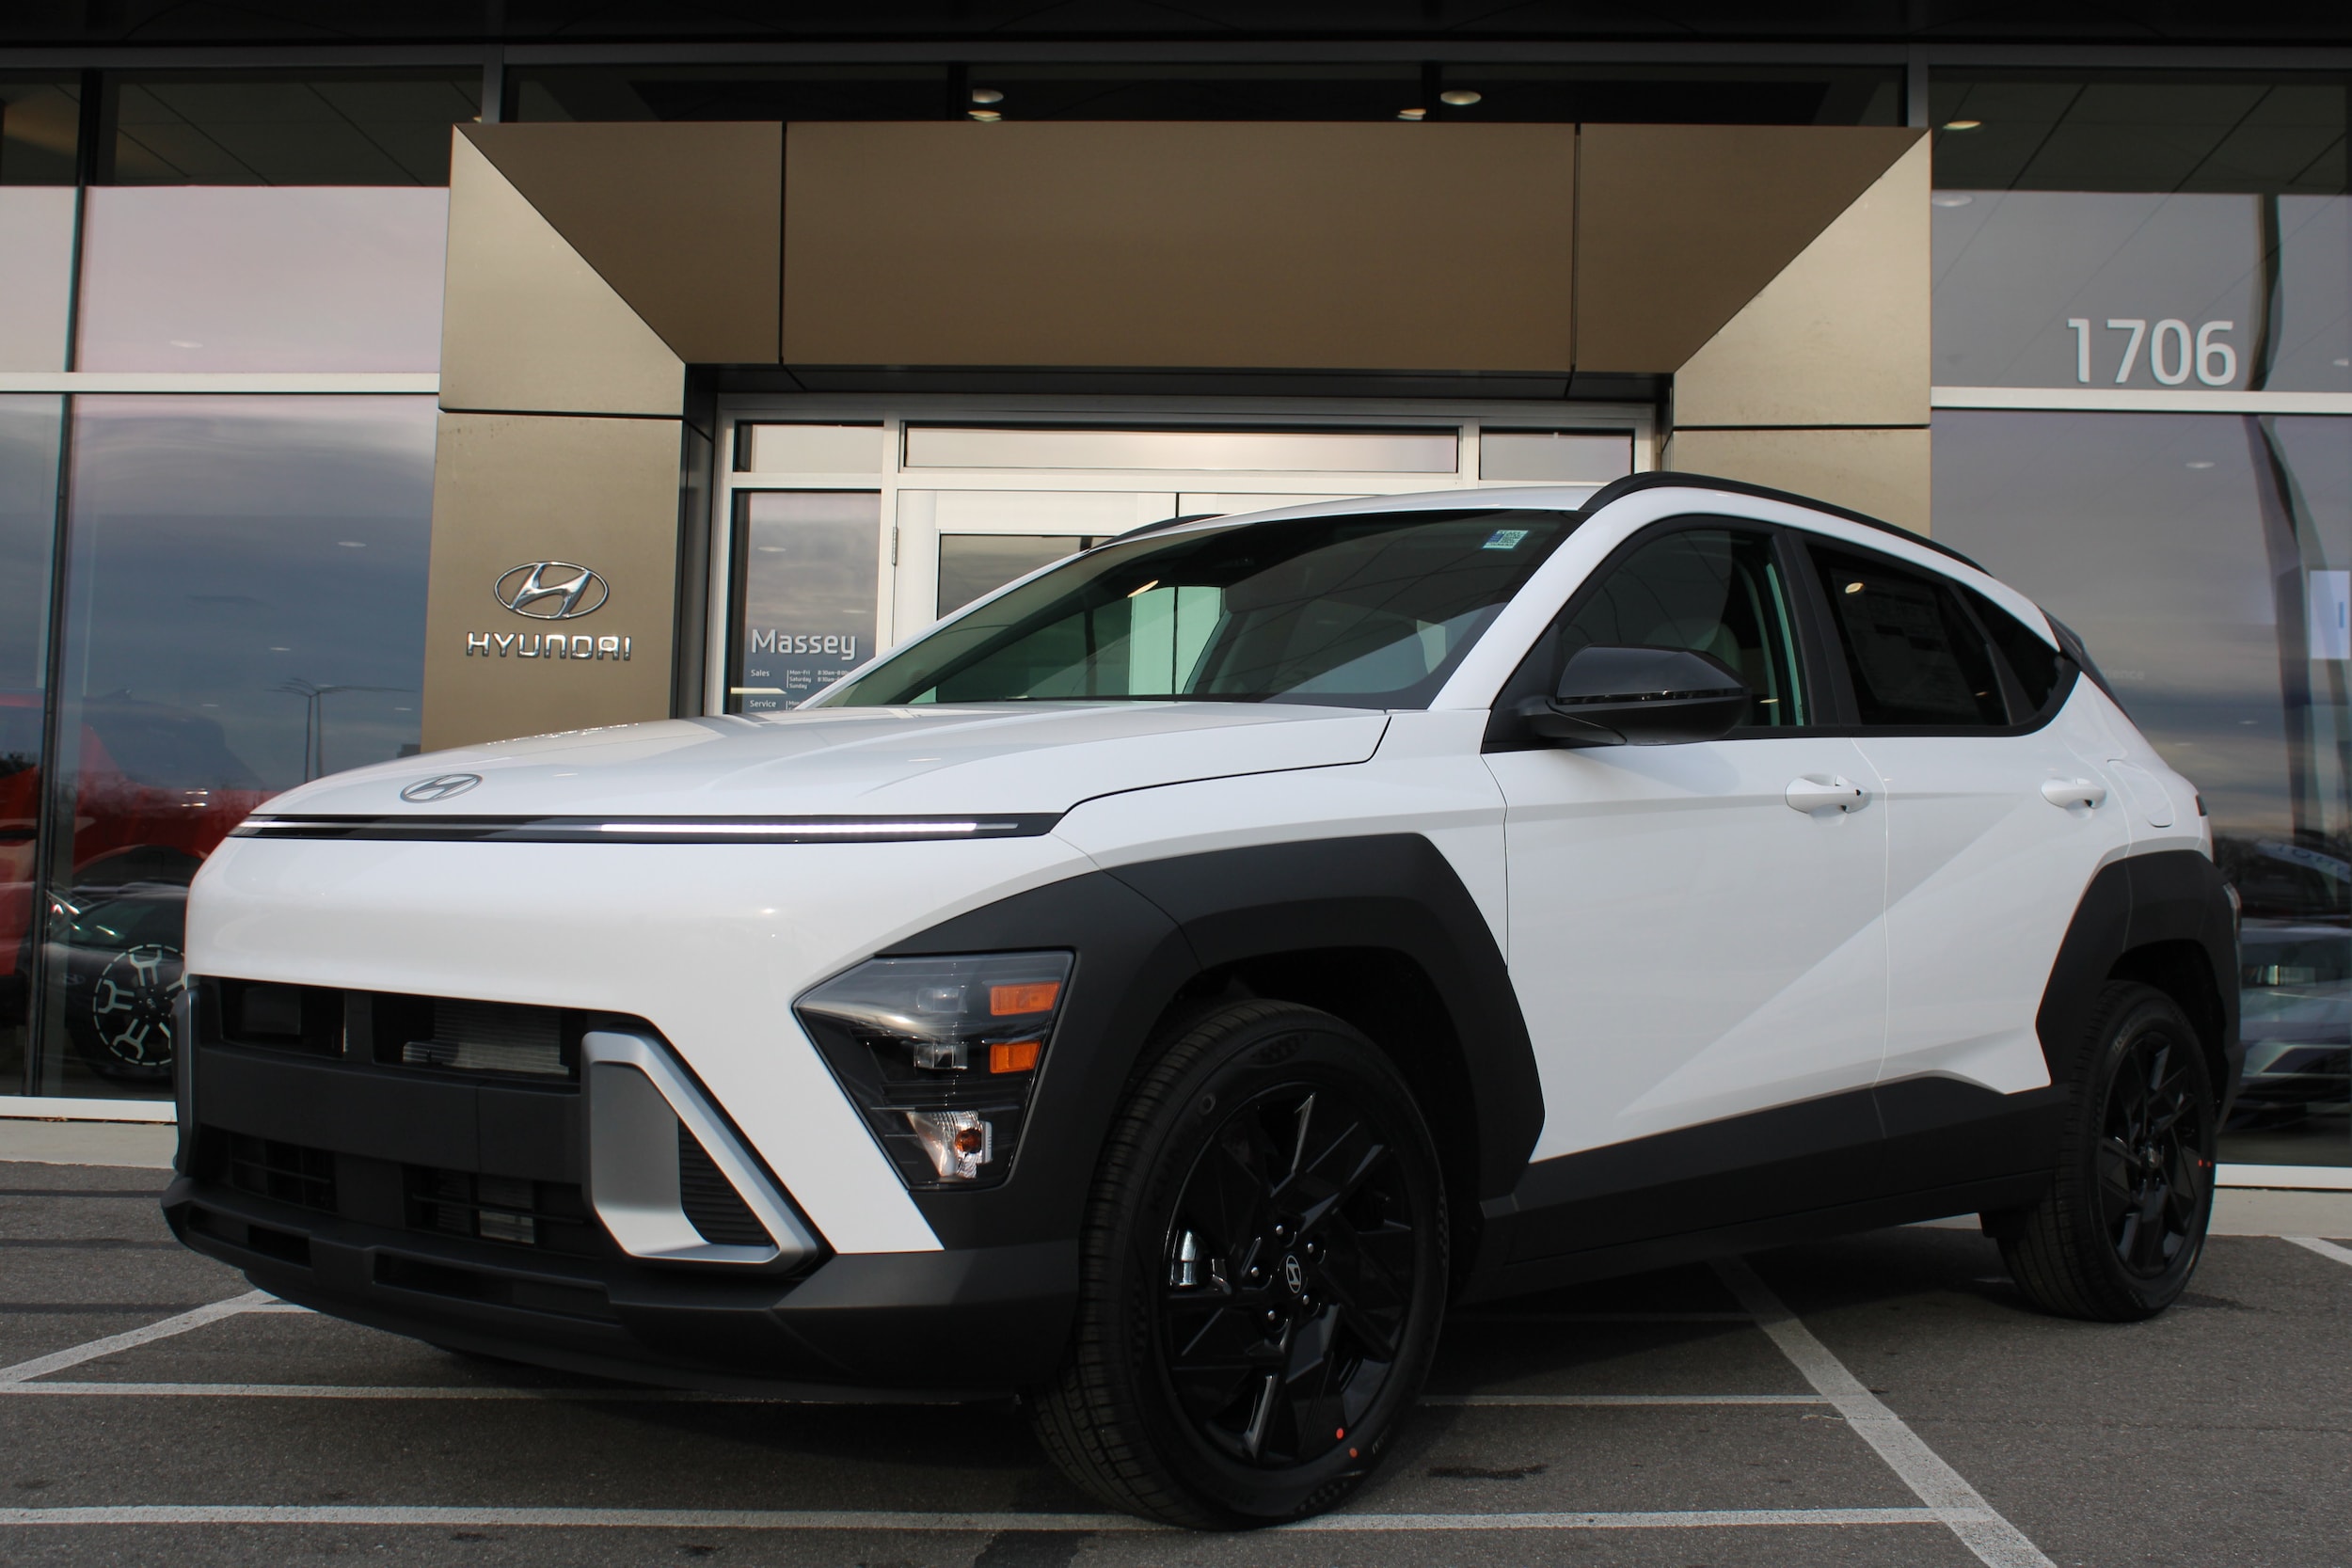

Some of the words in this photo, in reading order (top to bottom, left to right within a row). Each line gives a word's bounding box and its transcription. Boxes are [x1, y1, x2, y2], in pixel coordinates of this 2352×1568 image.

[2068, 318, 2236, 386] 1706
[467, 632, 631, 660] HYUNDAI
[752, 628, 856, 660] Massey
[750, 699, 776, 708] Service
